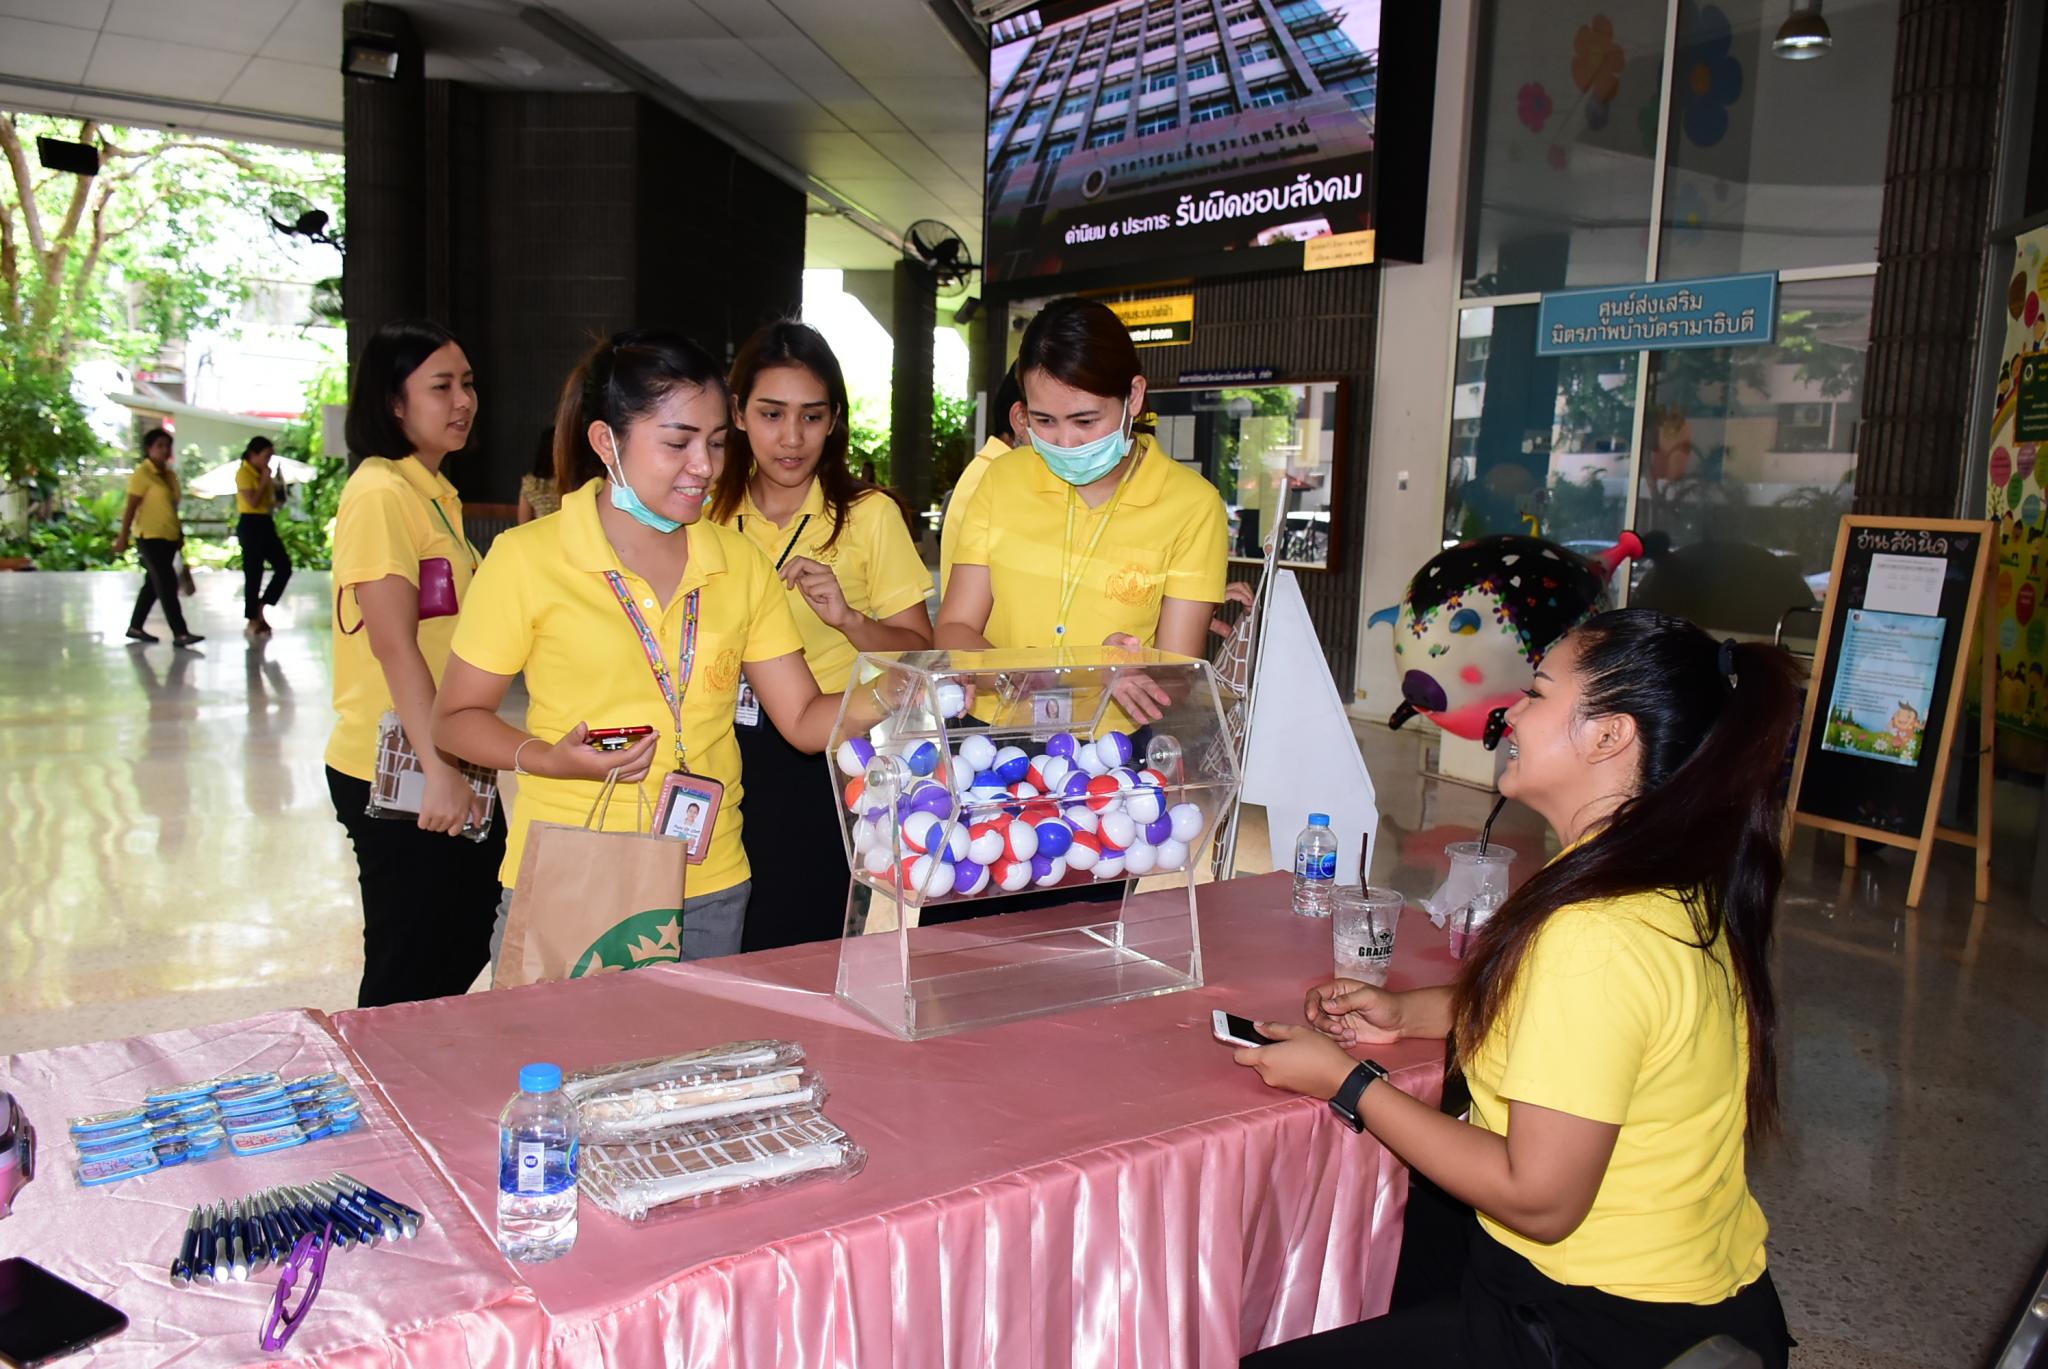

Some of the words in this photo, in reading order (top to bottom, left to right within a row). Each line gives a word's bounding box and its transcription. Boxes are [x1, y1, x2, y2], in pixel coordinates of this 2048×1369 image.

[1065, 222, 1106, 245] ค่านิยม
[1109, 221, 1119, 238] 6
[1175, 173, 1362, 226] รับผิดชอบสังคม
[1599, 289, 1703, 326] ศูนย์ส่งเสริม
[1552, 309, 1754, 344] มิตรภาพบำบัดรามาธิบดี
